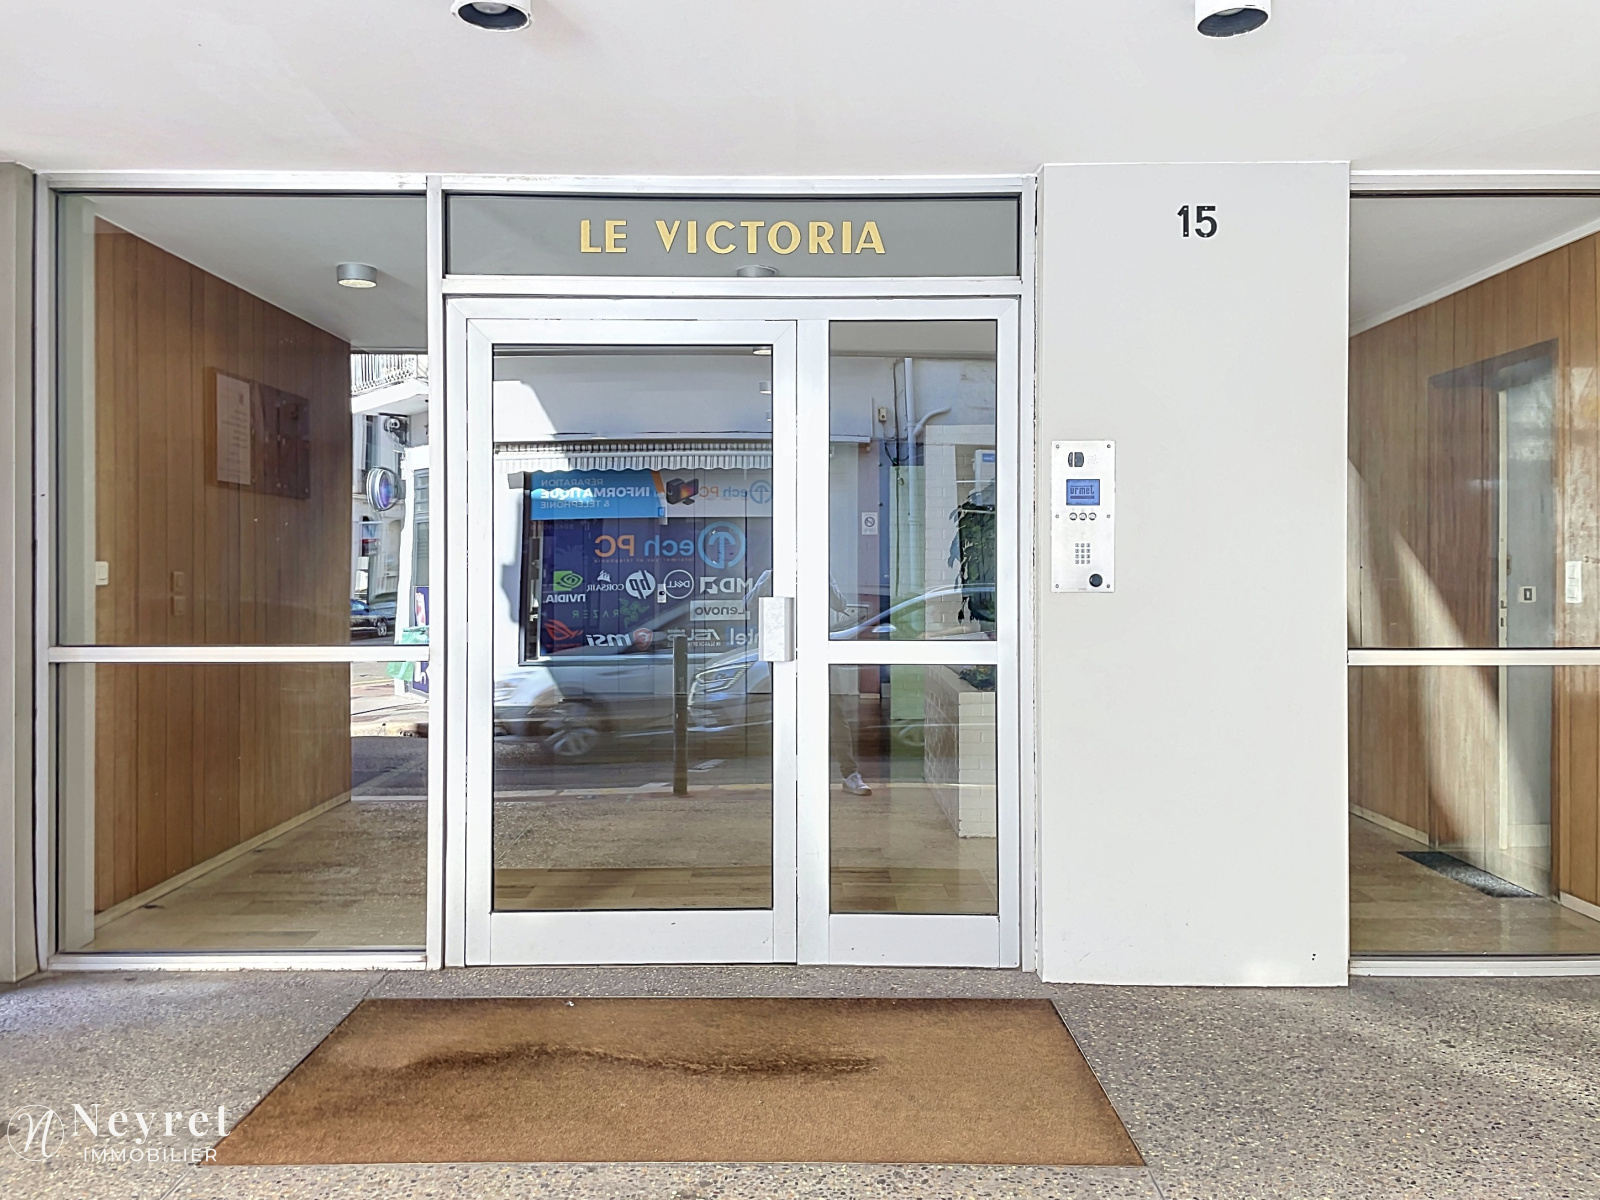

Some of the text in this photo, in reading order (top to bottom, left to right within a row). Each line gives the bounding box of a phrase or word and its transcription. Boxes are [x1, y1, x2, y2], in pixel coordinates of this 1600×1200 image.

[580, 219, 886, 255] LE VICTORIA
[1177, 205, 1218, 238] 15
[1070, 484, 1095, 495] urmet
